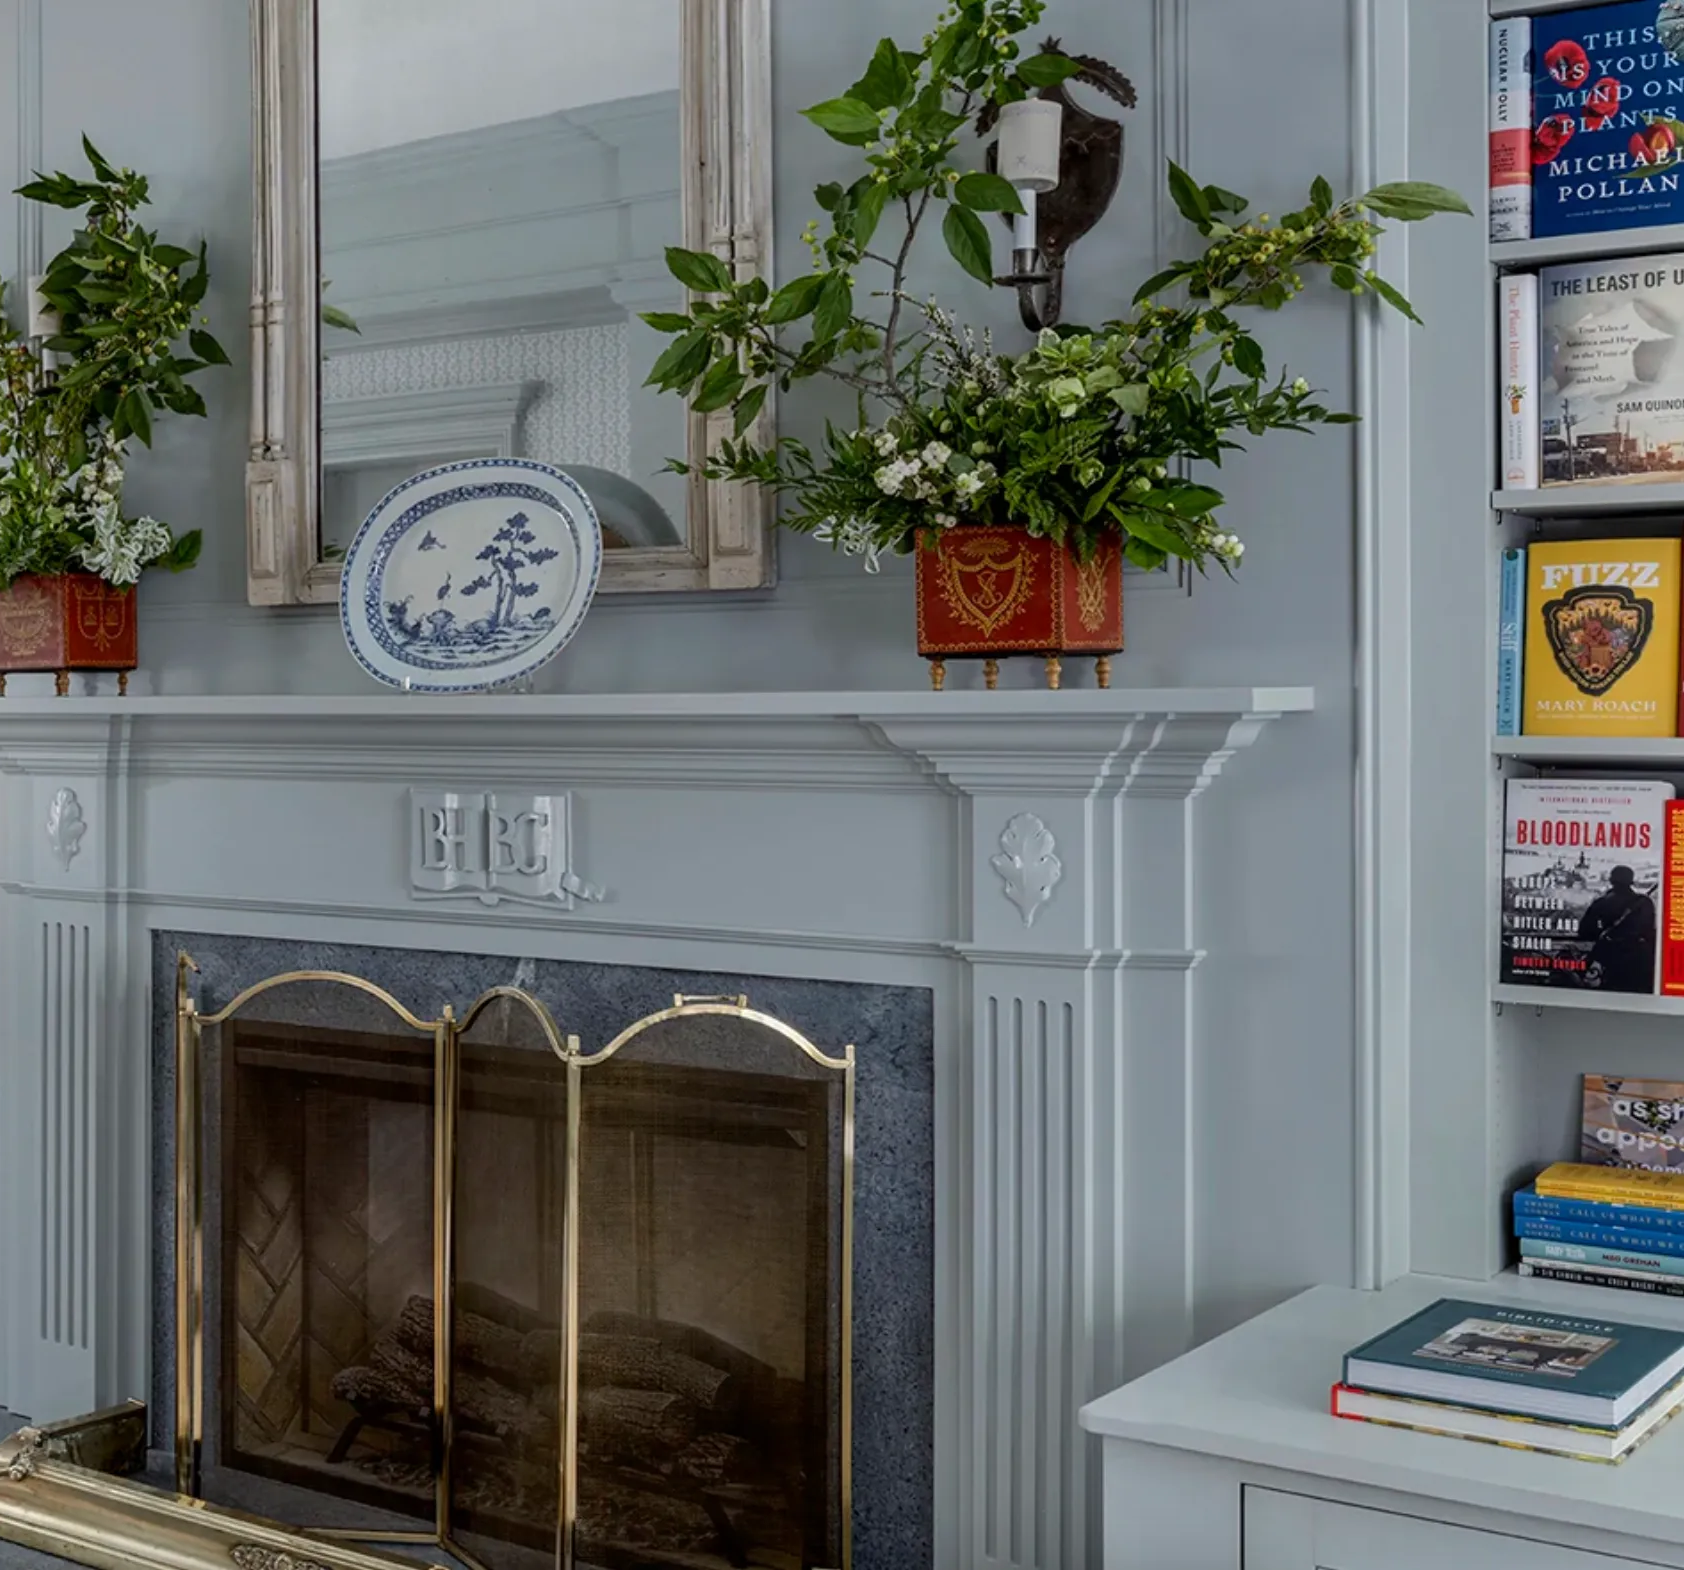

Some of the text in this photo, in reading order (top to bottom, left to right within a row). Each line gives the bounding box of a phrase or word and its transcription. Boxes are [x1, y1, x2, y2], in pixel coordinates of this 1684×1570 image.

[1583, 26, 1655, 50] THIS
[1498, 28, 1508, 83] NUCLEAR
[1559, 51, 1680, 81] IS YOUR
[1554, 78, 1684, 109] MIND ON
[1561, 106, 1677, 135] PLANTS
[1558, 174, 1680, 203] POLLAN
[1551, 270, 1666, 297] THE LEAST OF
[1616, 399, 1643, 414] SAM
[1541, 561, 1660, 590] FUZZ
[1536, 700, 1657, 712] MARY ROACH
[1516, 819, 1652, 849] BLOODLANDS
[1514, 875, 1556, 890] EUROPE
[1514, 896, 1565, 911] BETWEEN
[1513, 916, 1579, 932] HITLER AND
[1512, 936, 1553, 951] STALIN
[1612, 1099, 1647, 1119] as
[1619, 1212, 1651, 1225] WHAT
